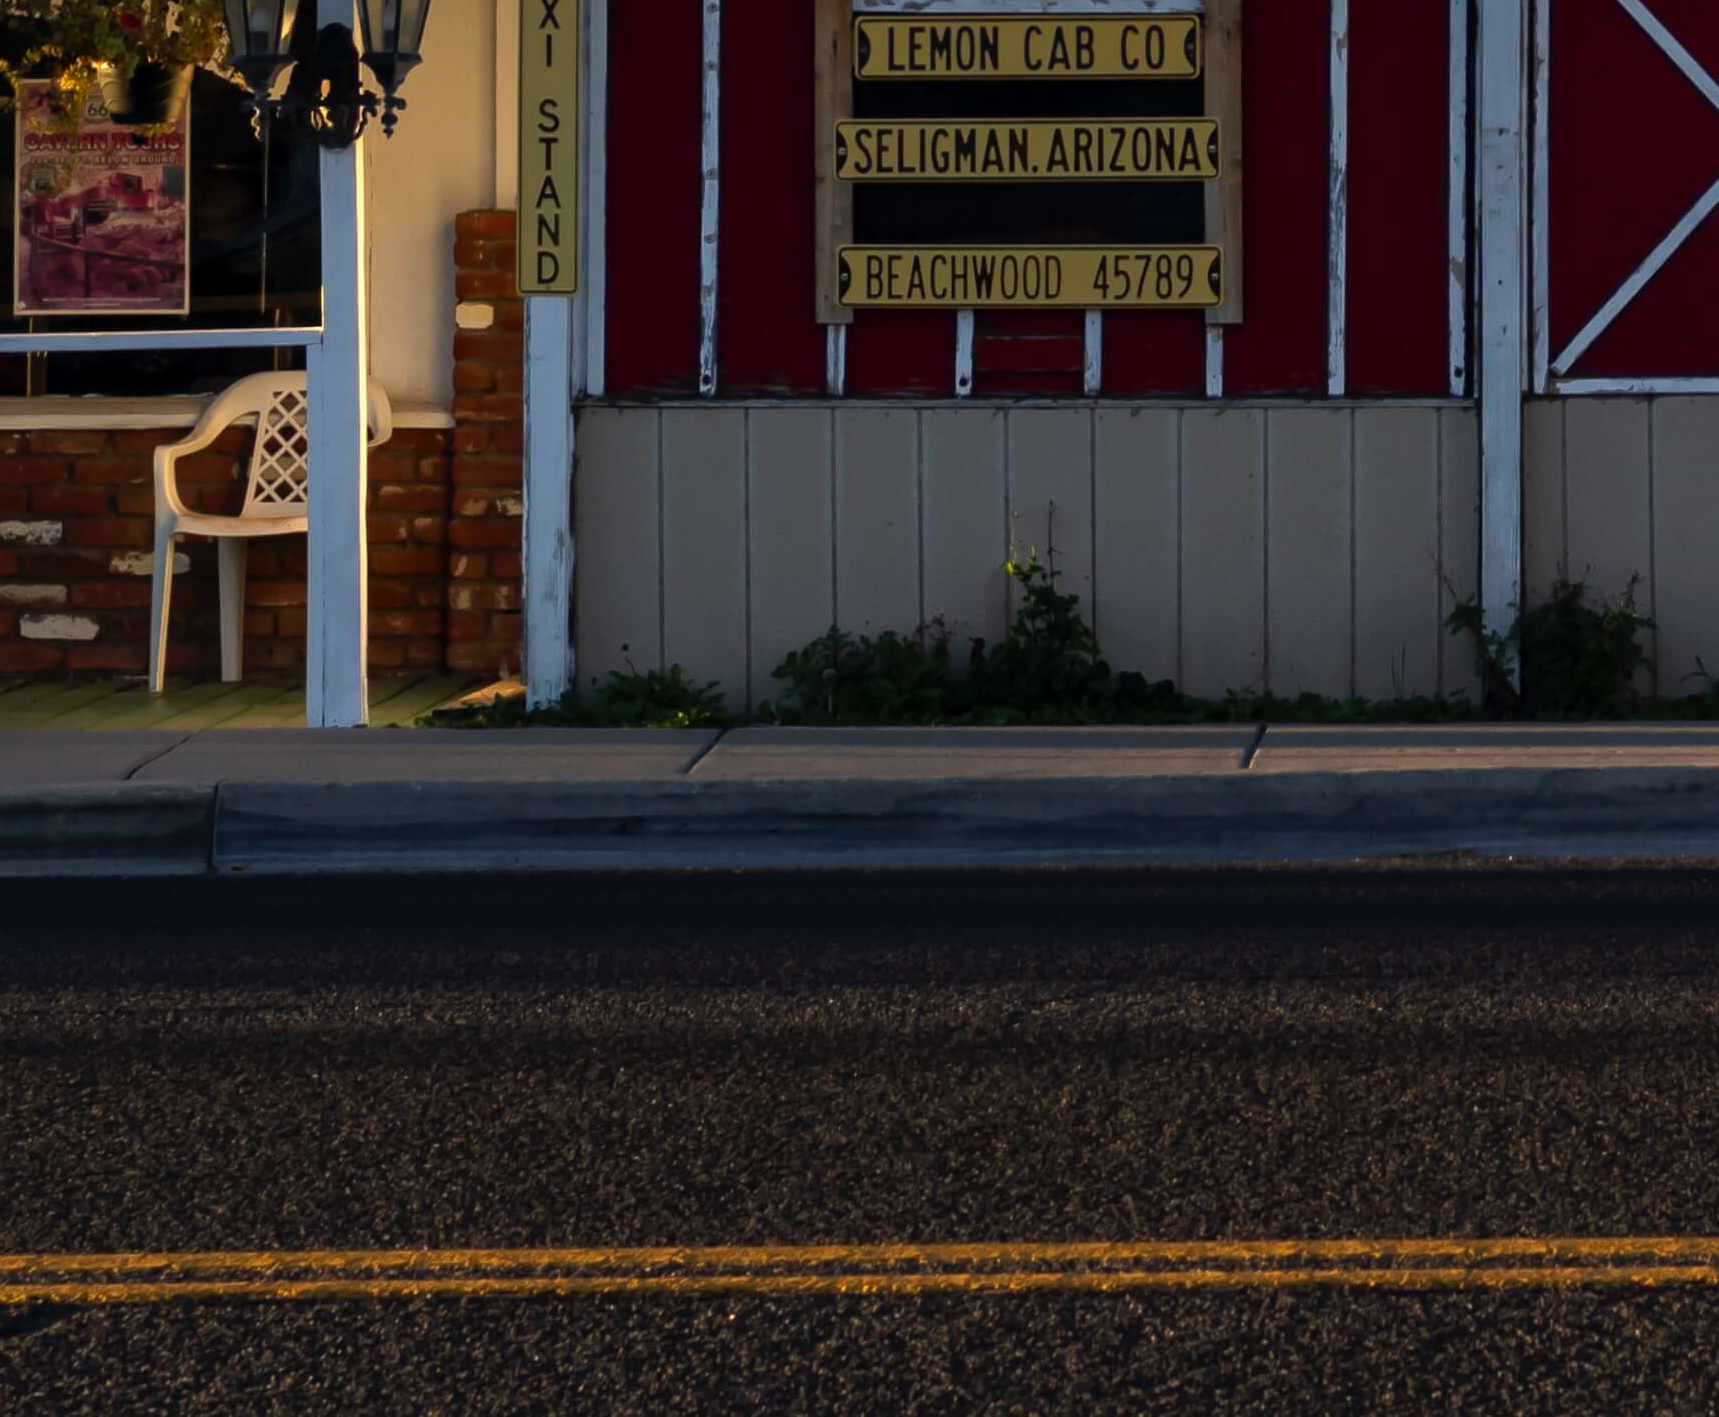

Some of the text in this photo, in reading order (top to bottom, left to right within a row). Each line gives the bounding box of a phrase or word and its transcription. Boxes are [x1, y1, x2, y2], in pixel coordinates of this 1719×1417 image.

[887, 25, 1166, 72] LEMON CAB CO
[1046, 127, 1202, 173] ARIZONA
[535, 98, 562, 285] STAND
[865, 253, 1194, 300] BEACHWOOD 45789
